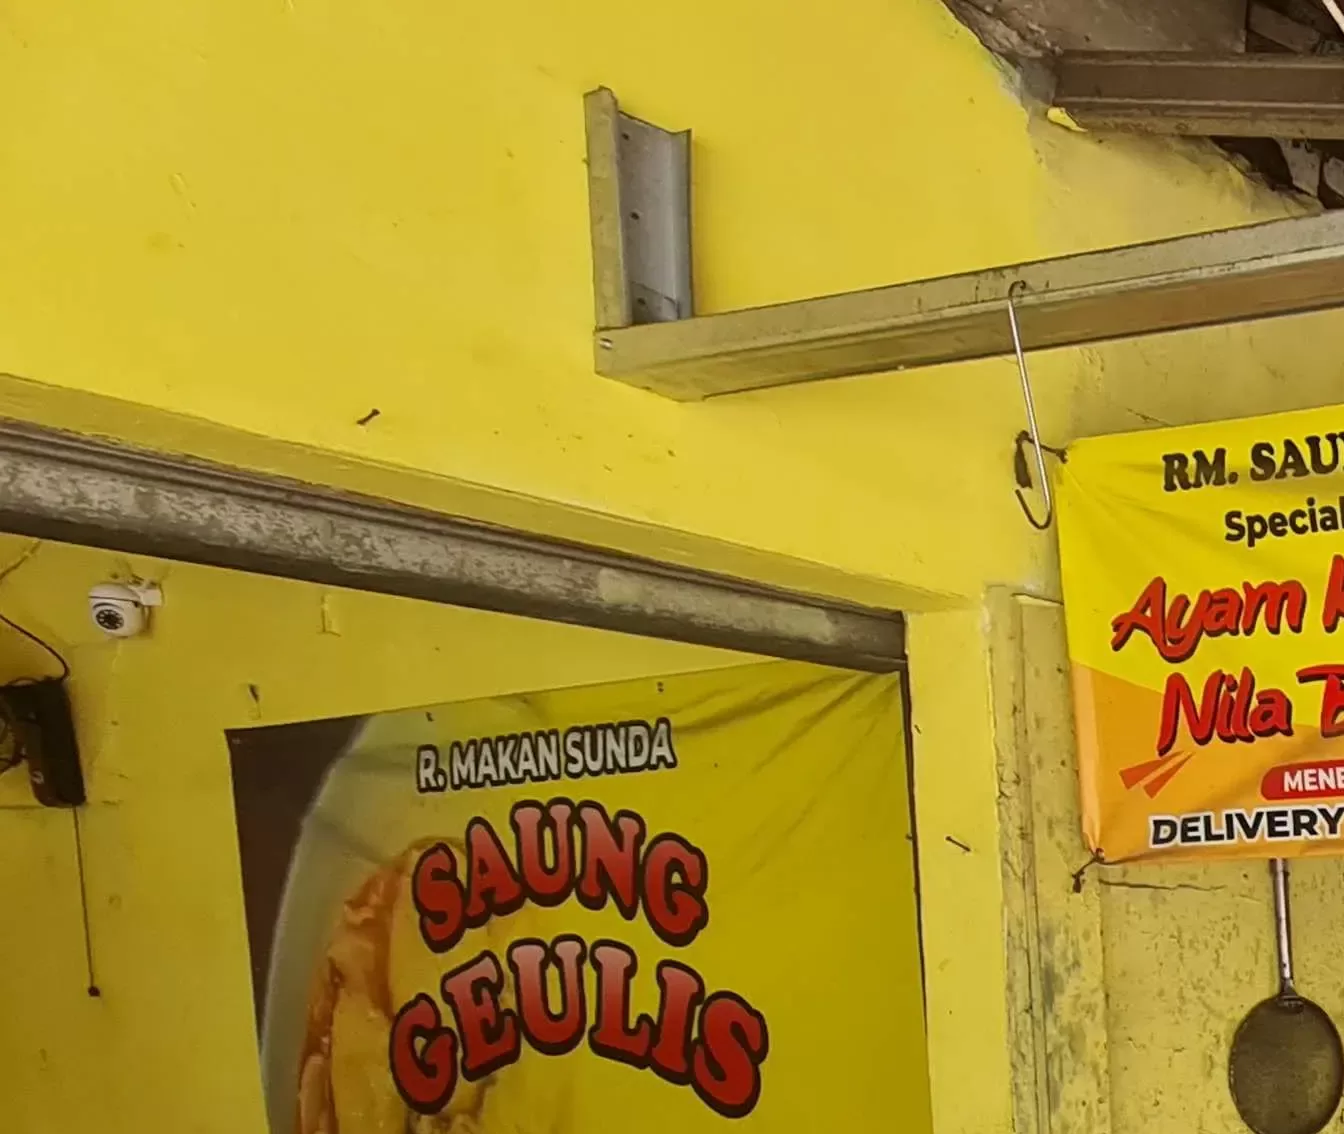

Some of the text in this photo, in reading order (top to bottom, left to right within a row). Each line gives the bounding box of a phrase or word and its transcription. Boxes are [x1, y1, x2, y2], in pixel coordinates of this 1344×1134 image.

[1162, 448, 1238, 492] RM.
[1112, 575, 1306, 661] Ayam
[417, 719, 676, 792] R. MAKAN SUNDA
[1156, 672, 1292, 756] Nila
[412, 797, 709, 952] SAUNG
[390, 935, 768, 1118] GEULIS
